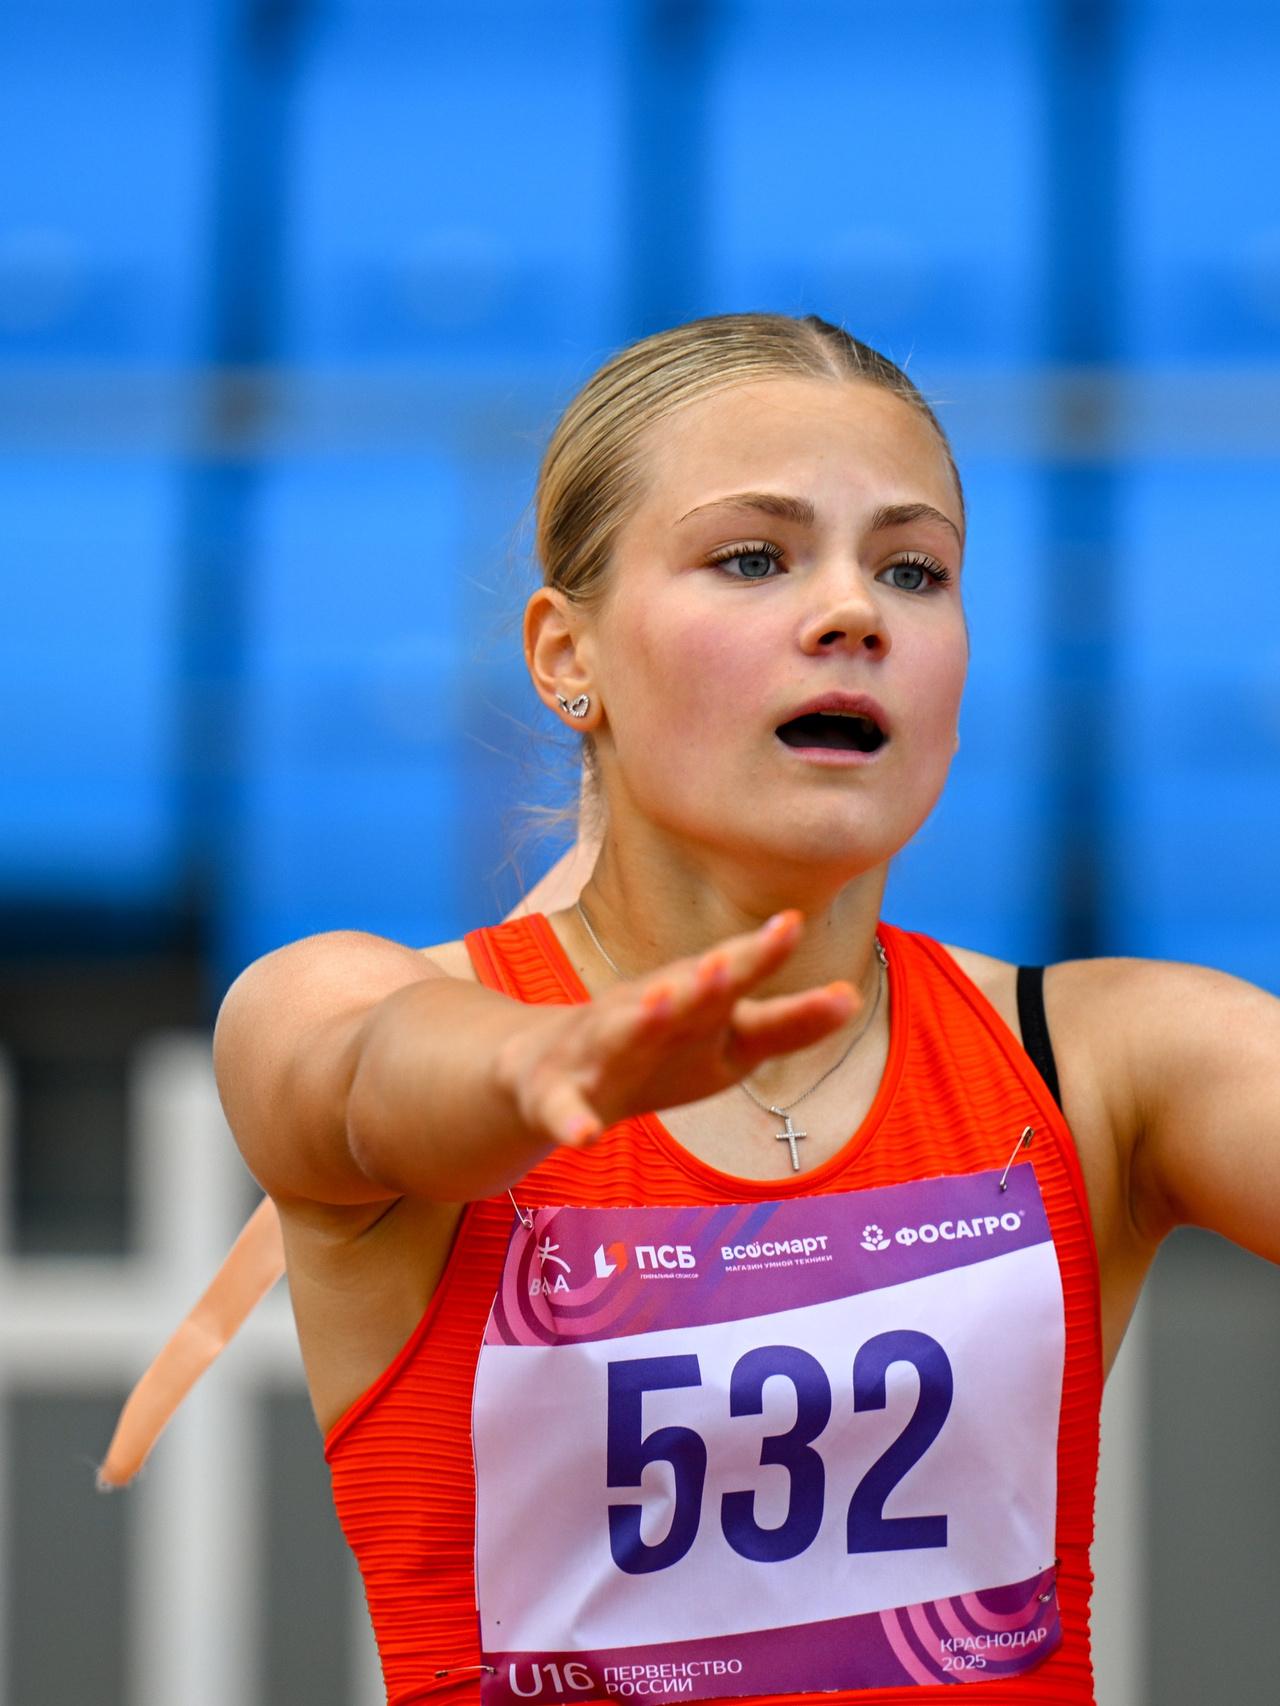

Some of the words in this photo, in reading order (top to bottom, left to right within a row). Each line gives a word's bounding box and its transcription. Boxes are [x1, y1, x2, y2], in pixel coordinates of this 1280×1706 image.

[635, 1246, 696, 1269] ПСБ
[725, 1264, 763, 1272] МАГАЗИН
[764, 1259, 793, 1269] УМНОЙ
[794, 1254, 833, 1266] ТЕХНИКИ
[606, 1329, 954, 1575] 532
[940, 1627, 1047, 1653] КРАСНОДАР
[604, 1659, 743, 1682] ПЕРВЕНСТВО
[942, 1654, 987, 1672] 2025
[509, 1662, 595, 1697] U16
[606, 1678, 693, 1697] РОССИИ
